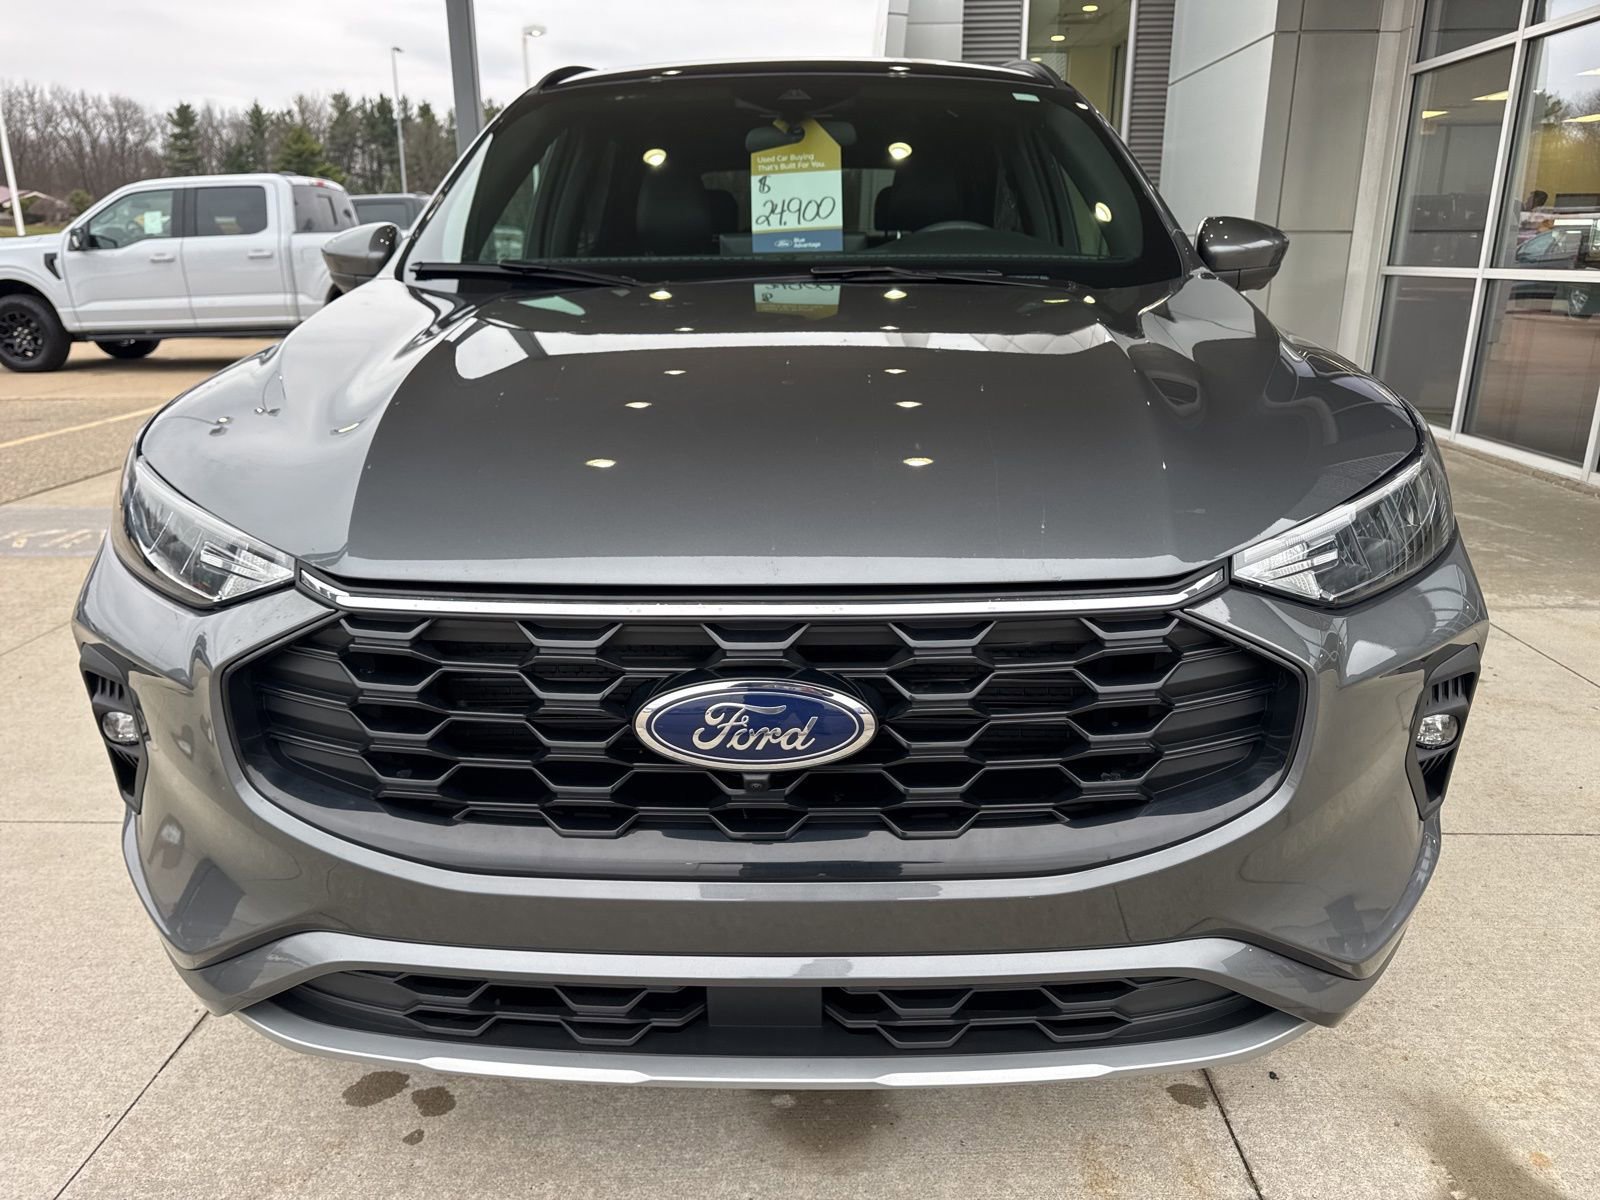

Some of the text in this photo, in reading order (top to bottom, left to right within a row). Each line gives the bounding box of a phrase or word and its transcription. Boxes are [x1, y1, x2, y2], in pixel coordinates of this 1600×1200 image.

[757, 155, 776, 163] Used
[790, 153, 814, 161] Buying
[758, 163, 778, 171] That's
[779, 162, 797, 170] Built
[797, 160, 810, 168] For
[692, 702, 819, 751] Ford
